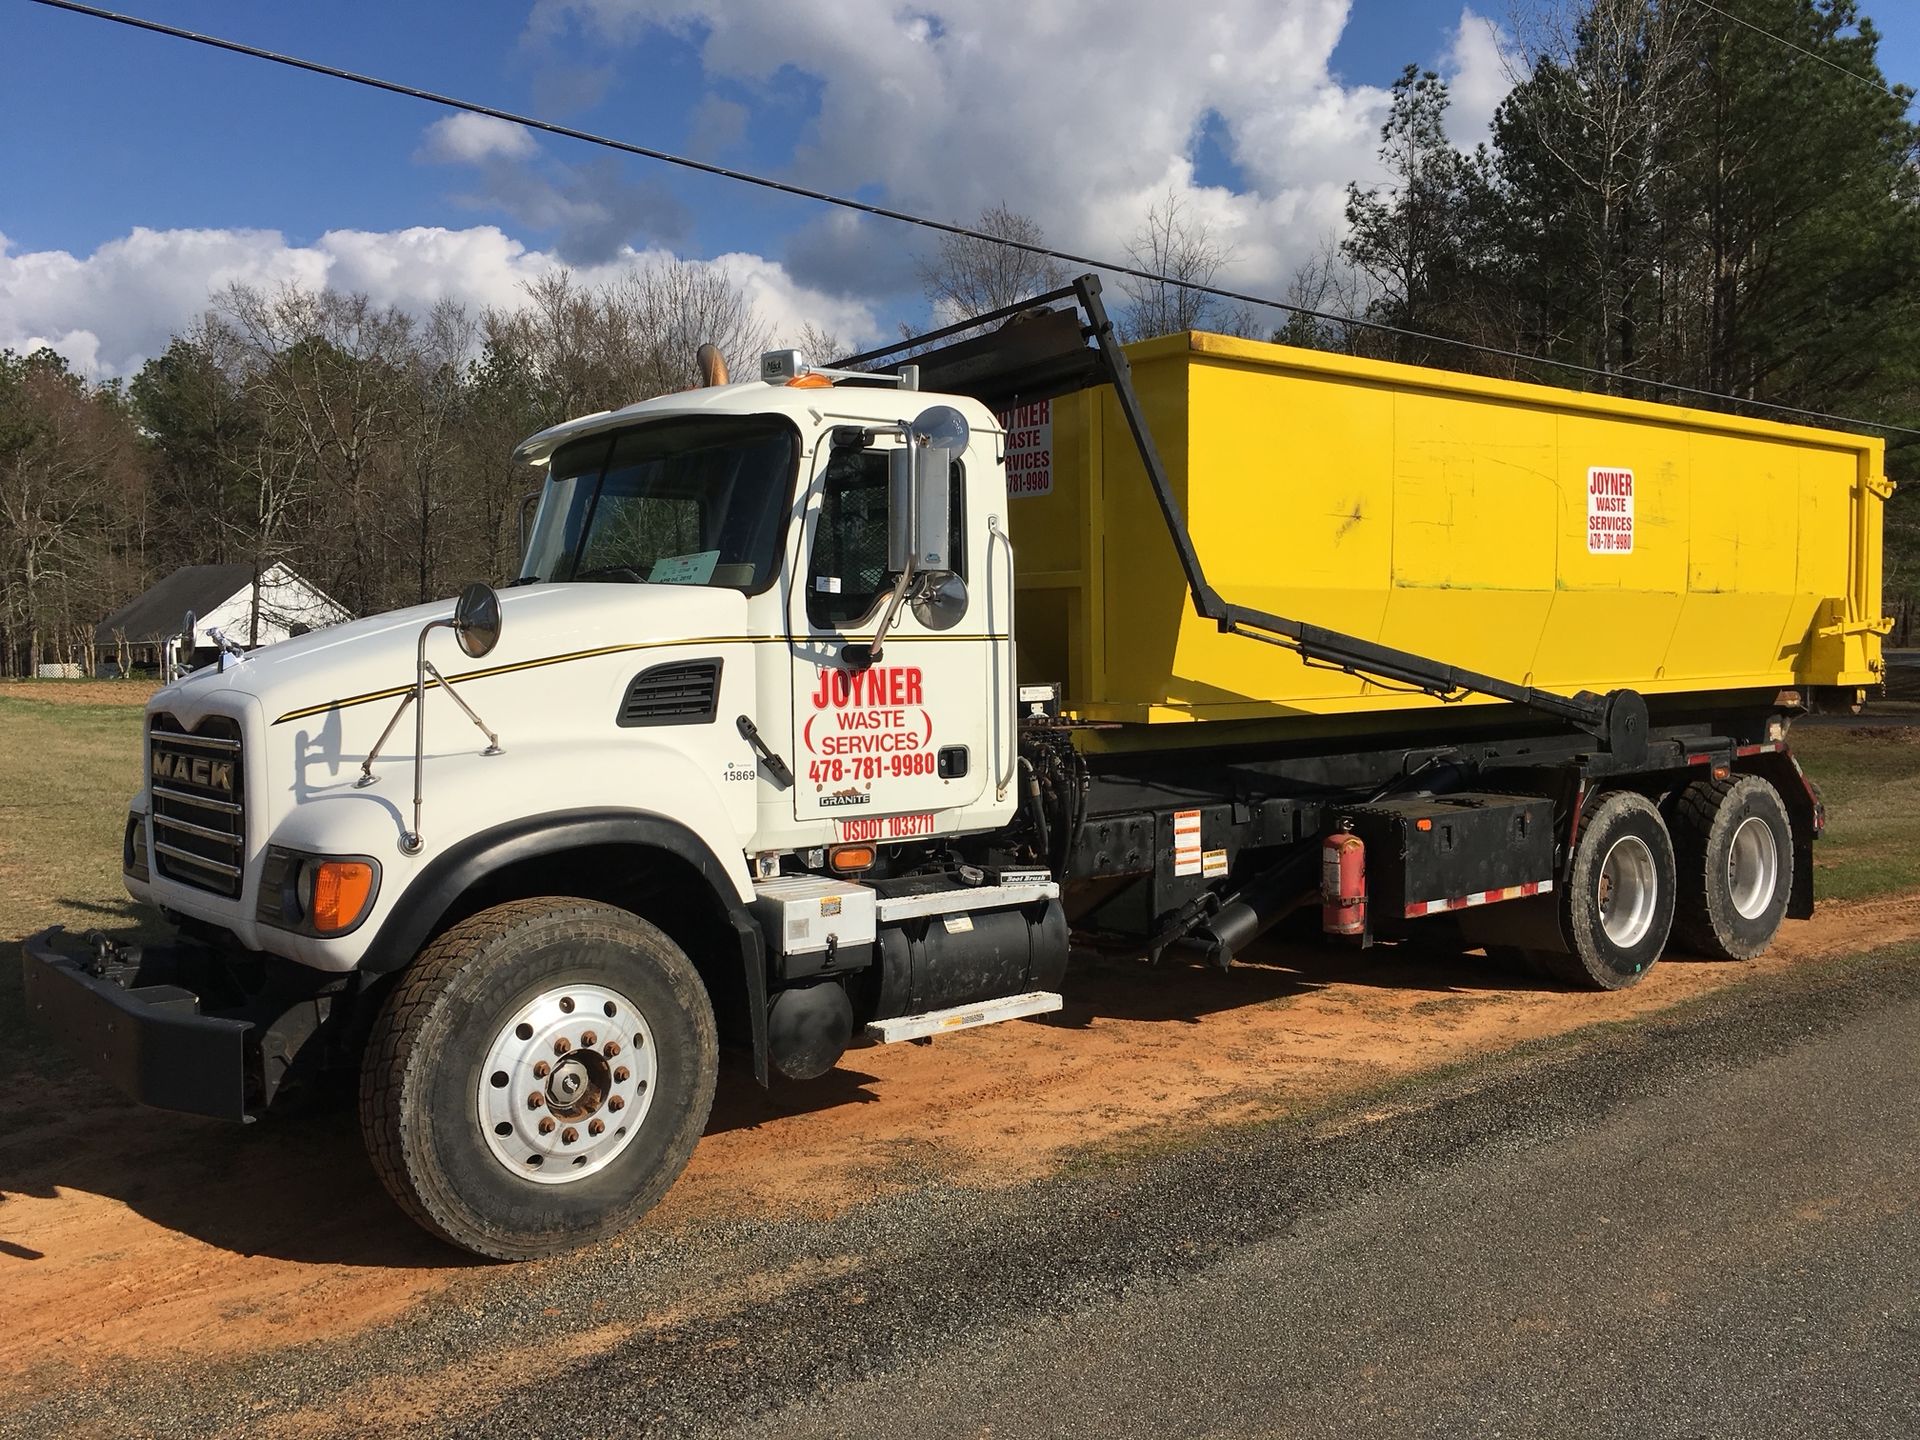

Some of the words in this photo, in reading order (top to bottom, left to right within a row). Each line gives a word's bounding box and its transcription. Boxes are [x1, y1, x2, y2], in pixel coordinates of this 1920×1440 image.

[997, 400, 1049, 429] OYNER
[1005, 429, 1040, 449] ASTE
[1005, 450, 1049, 472] RVICES
[1590, 472, 1632, 496] JOYNER
[1596, 497, 1626, 512] WASTE
[1589, 515, 1632, 531] SERVICES
[1589, 533, 1632, 550] 478-781-9980
[812, 666, 923, 710] JOYNER
[836, 710, 905, 730] WASTE
[822, 732, 919, 755] SERVICES
[152, 752, 232, 791] MACK
[723, 770, 755, 781] 15869
[809, 752, 935, 783] 478-781-9980
[843, 819, 884, 841] USDOT
[888, 814, 935, 837] 1033711
